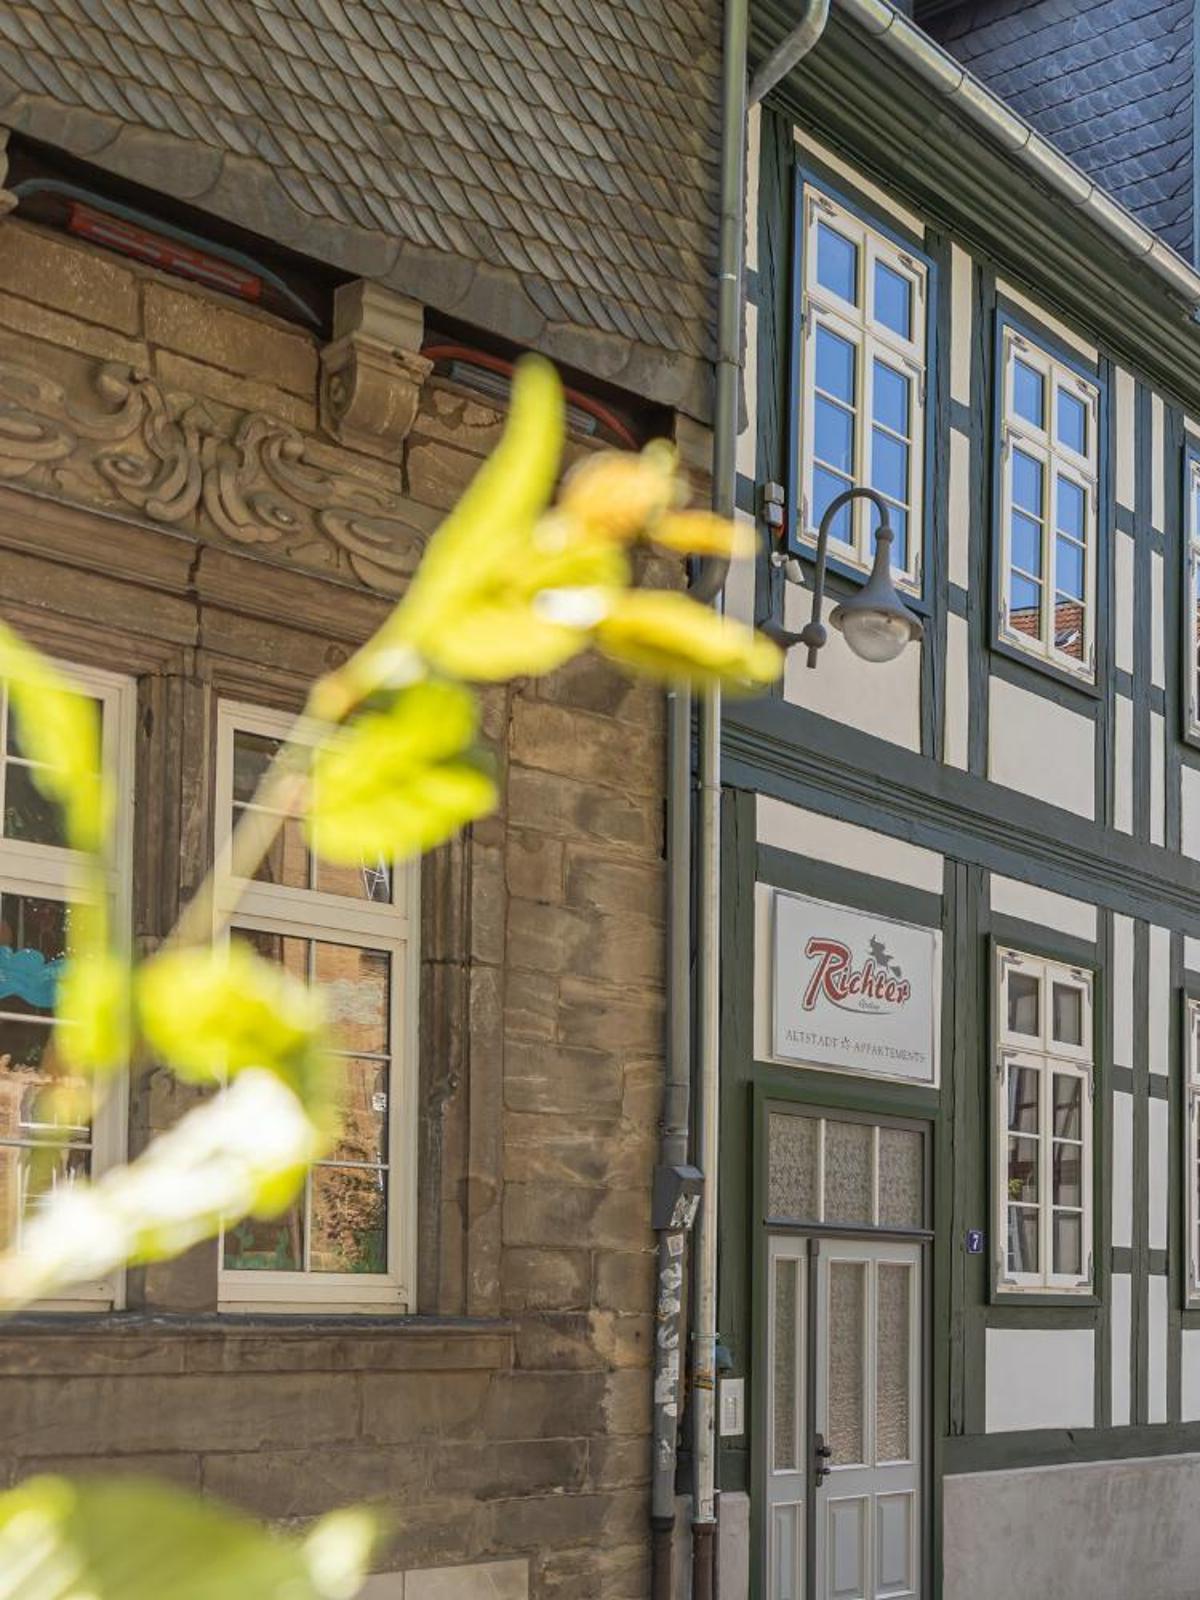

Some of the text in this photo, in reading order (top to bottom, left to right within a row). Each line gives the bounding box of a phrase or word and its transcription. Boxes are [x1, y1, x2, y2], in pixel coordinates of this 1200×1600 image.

[803, 936, 911, 1011] Richter
[784, 1028, 839, 1048] ALTSTADT
[972, 1233, 979, 1251] 7
